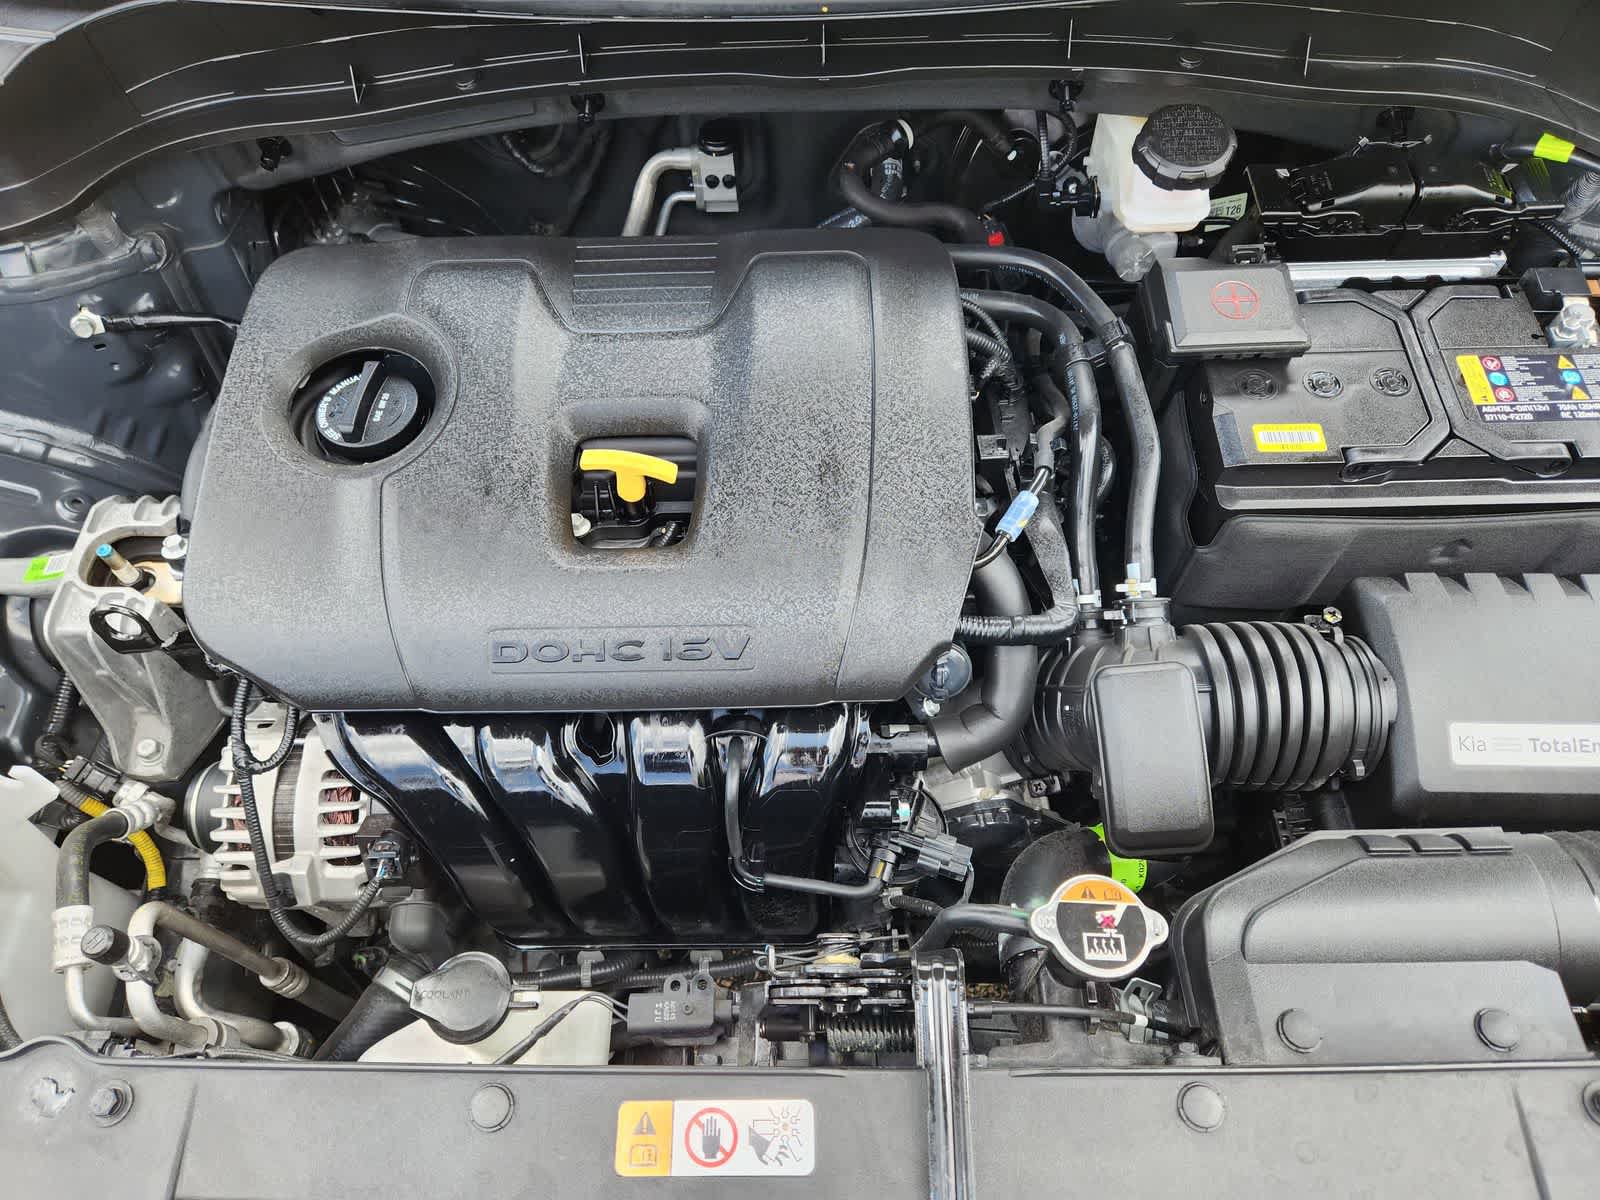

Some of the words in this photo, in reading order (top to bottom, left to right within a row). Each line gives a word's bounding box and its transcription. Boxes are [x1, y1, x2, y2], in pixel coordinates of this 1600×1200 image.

[328, 374, 362, 395] MANUA
[491, 638, 645, 664] DOHC
[661, 637, 751, 662] 16V
[1458, 735, 1488, 752] Kia
[1527, 736, 1600, 753] TotalEn
